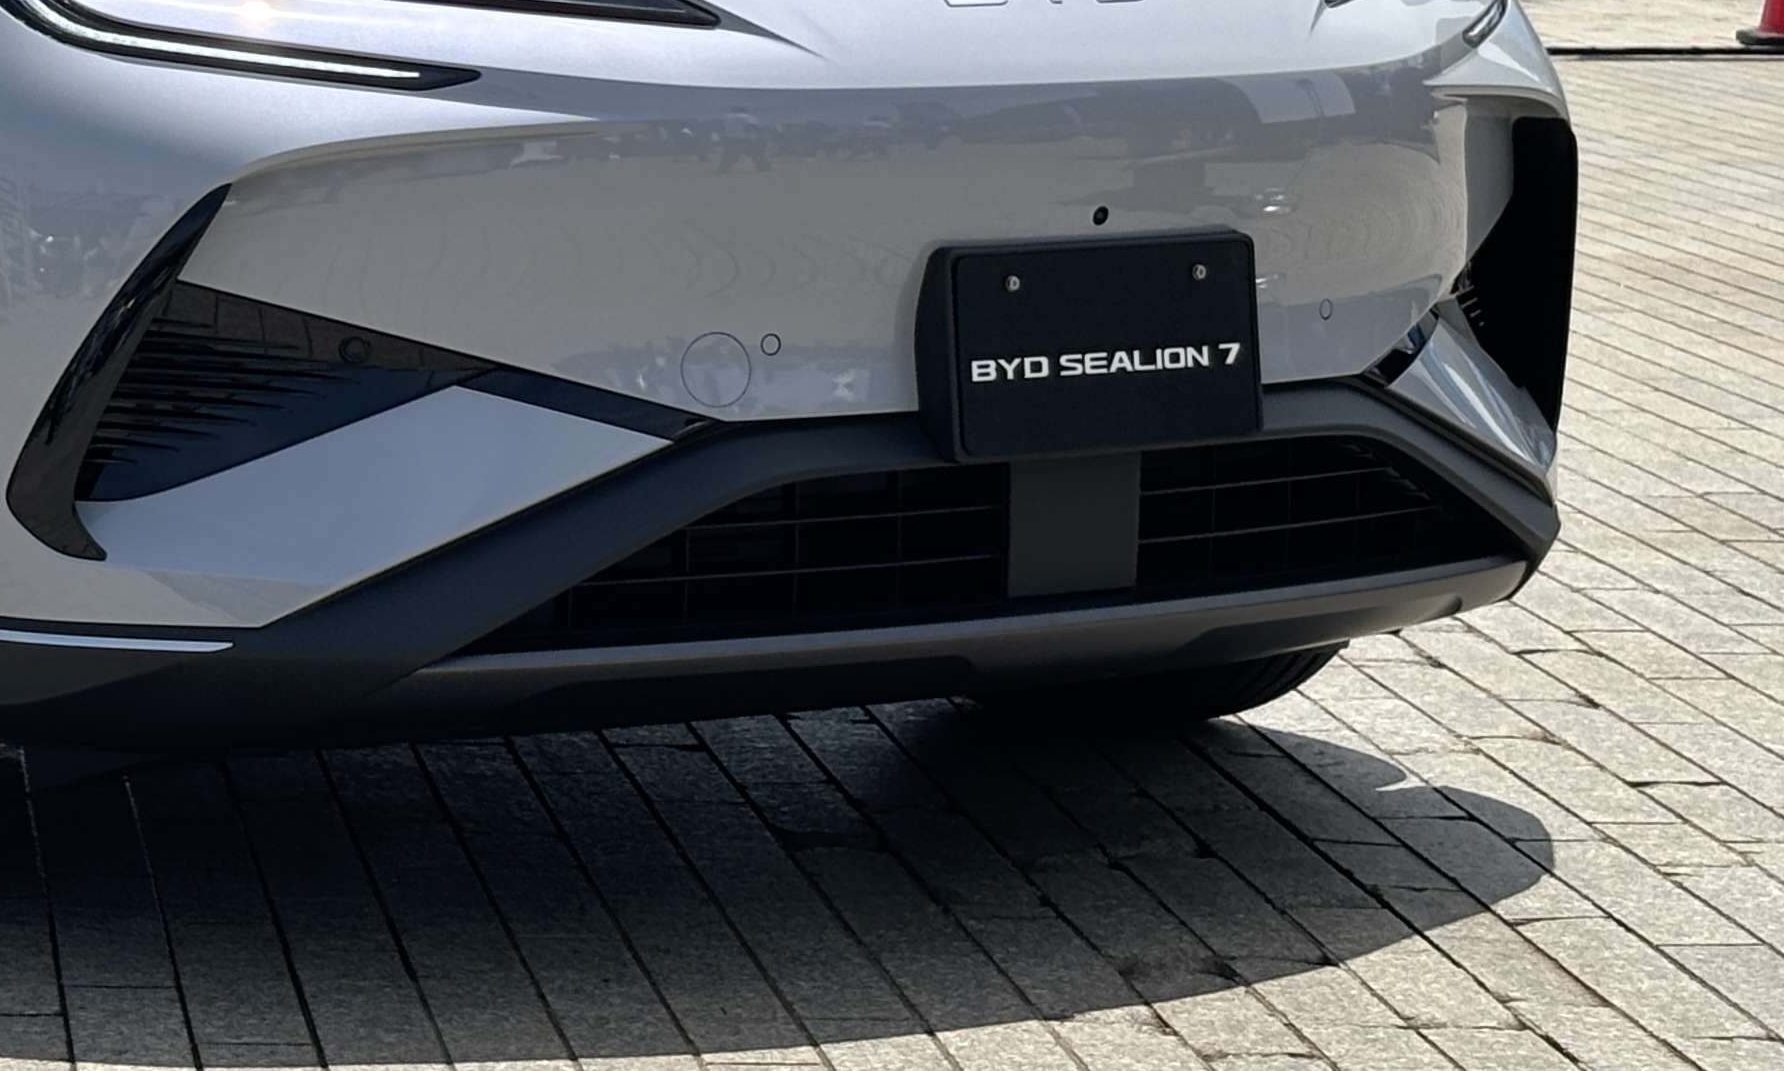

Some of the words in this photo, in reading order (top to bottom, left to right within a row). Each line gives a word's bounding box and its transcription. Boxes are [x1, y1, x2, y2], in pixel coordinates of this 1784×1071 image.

[970, 355, 1050, 382] BYD
[1059, 345, 1210, 377] SEALION
[1218, 342, 1242, 366] 7
